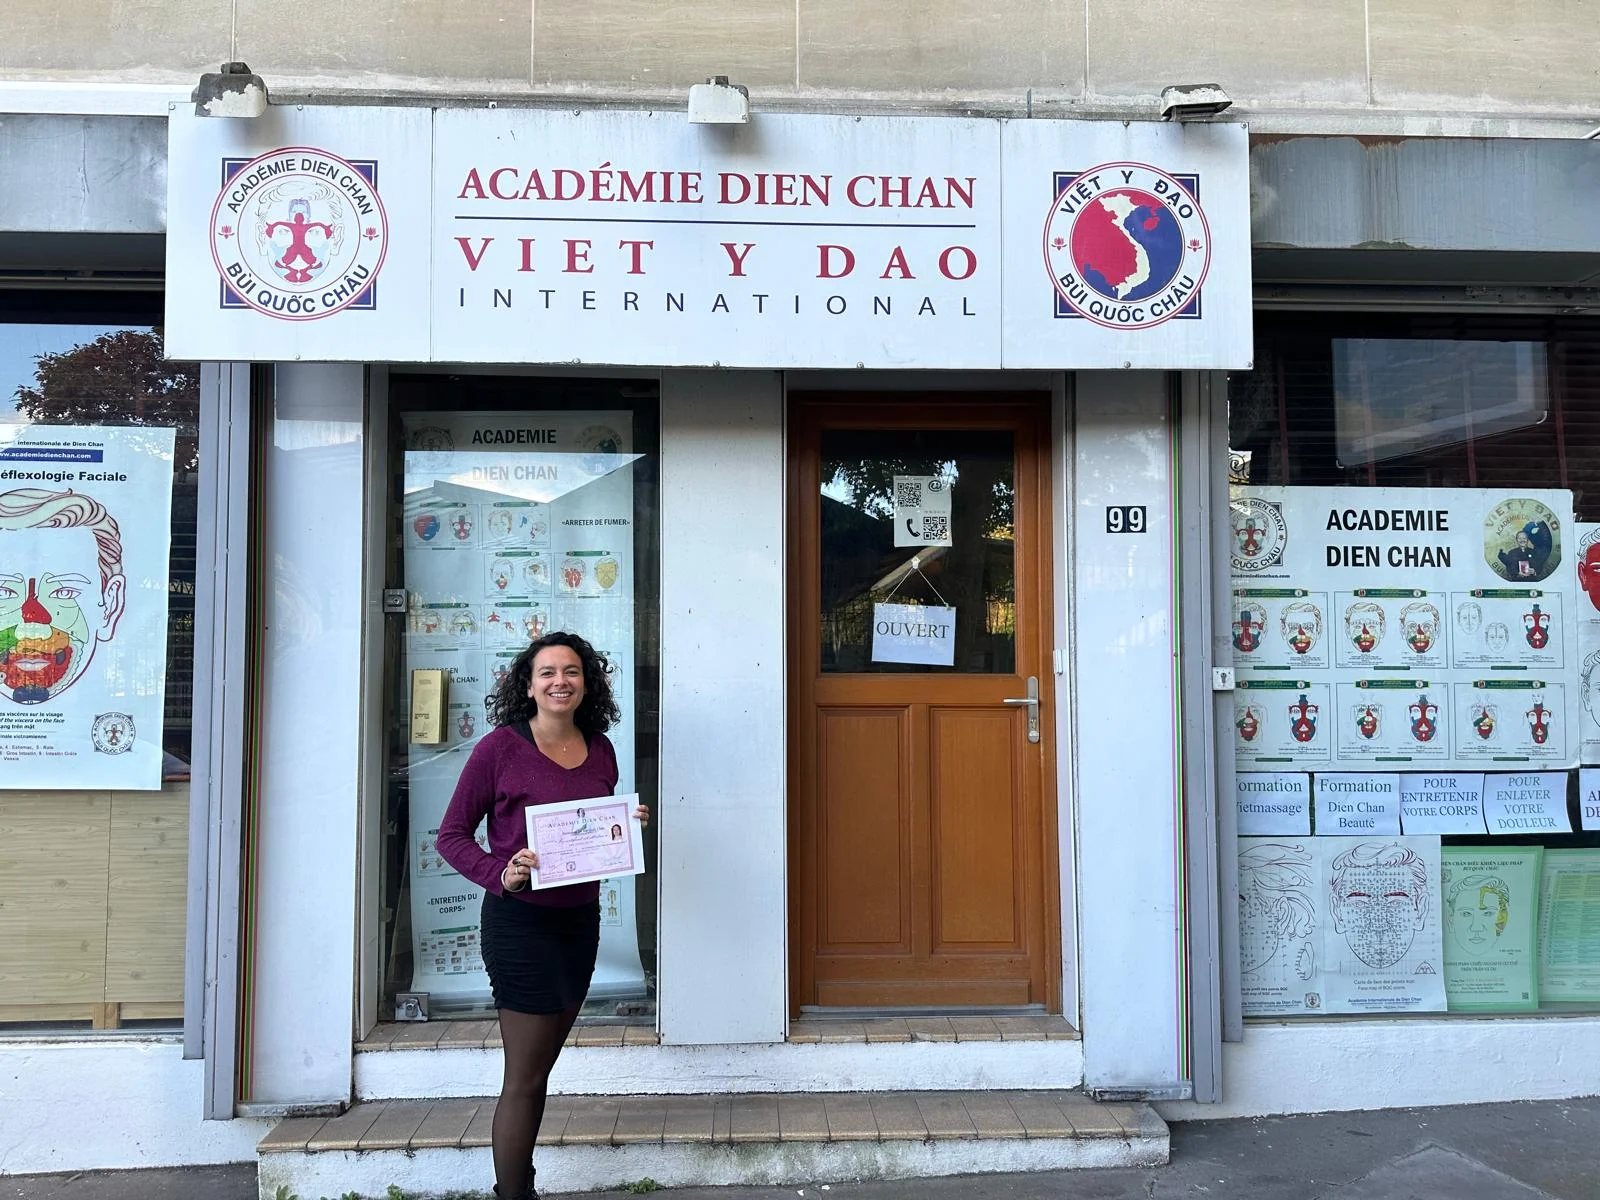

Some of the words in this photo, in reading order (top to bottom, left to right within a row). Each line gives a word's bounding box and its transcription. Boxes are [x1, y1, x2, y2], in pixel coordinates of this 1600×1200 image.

[228, 159, 296, 213] ACADÉMIE
[301, 159, 339, 179] DIEN
[340, 176, 373, 215] CHAN
[457, 161, 704, 203] ACADÉMIE
[717, 172, 832, 207] DIEN
[846, 175, 977, 209] CHAN
[1060, 176, 1101, 215] VIỆT
[1121, 171, 1133, 184] Y
[1153, 179, 1193, 218] ĐẠO
[454, 236, 654, 275] VIET
[719, 242, 756, 277] Y
[816, 244, 978, 281] DAO
[227, 262, 256, 294] BÙI
[258, 290, 315, 313] QUỐC
[322, 265, 369, 307] CHÂU
[459, 287, 976, 316] INTERNATIONAL
[1060, 273, 1088, 304] BÙI
[1089, 301, 1144, 322] QUỐC
[1150, 275, 1194, 316] CHÂU
[472, 429, 557, 444] ACADEMIE
[1, 470, 74, 482] éflexologie
[79, 472, 127, 481] Faciale
[472, 466, 509, 480] DIEN
[514, 466, 558, 480] CHAN
[1108, 507, 1145, 532] 99
[1250, 501, 1269, 510] DIEN
[1269, 509, 1284, 531] CHAN
[1326, 509, 1449, 531] ACADEMIE
[1326, 546, 1380, 567] DIEN
[1387, 546, 1451, 567] CHAN
[876, 621, 950, 640] OUVERT
[1237, 778, 1302, 792] ormation
[1320, 778, 1392, 792] Formation
[1424, 778, 1457, 788] POUR
[1508, 776, 1540, 786] POUR
[1401, 792, 1478, 802] ENTRETENIR
[1497, 790, 1551, 800] ENLEVER
[1237, 801, 1302, 815] ietmassage
[1328, 802, 1354, 812] Dien
[1357, 802, 1385, 813] Chan
[1403, 807, 1437, 817] VOTRE
[1439, 806, 1478, 816] CORPS
[1504, 804, 1545, 815] VOTRE
[1339, 817, 1375, 828] Beauté
[1498, 818, 1557, 829] DOULEUR
